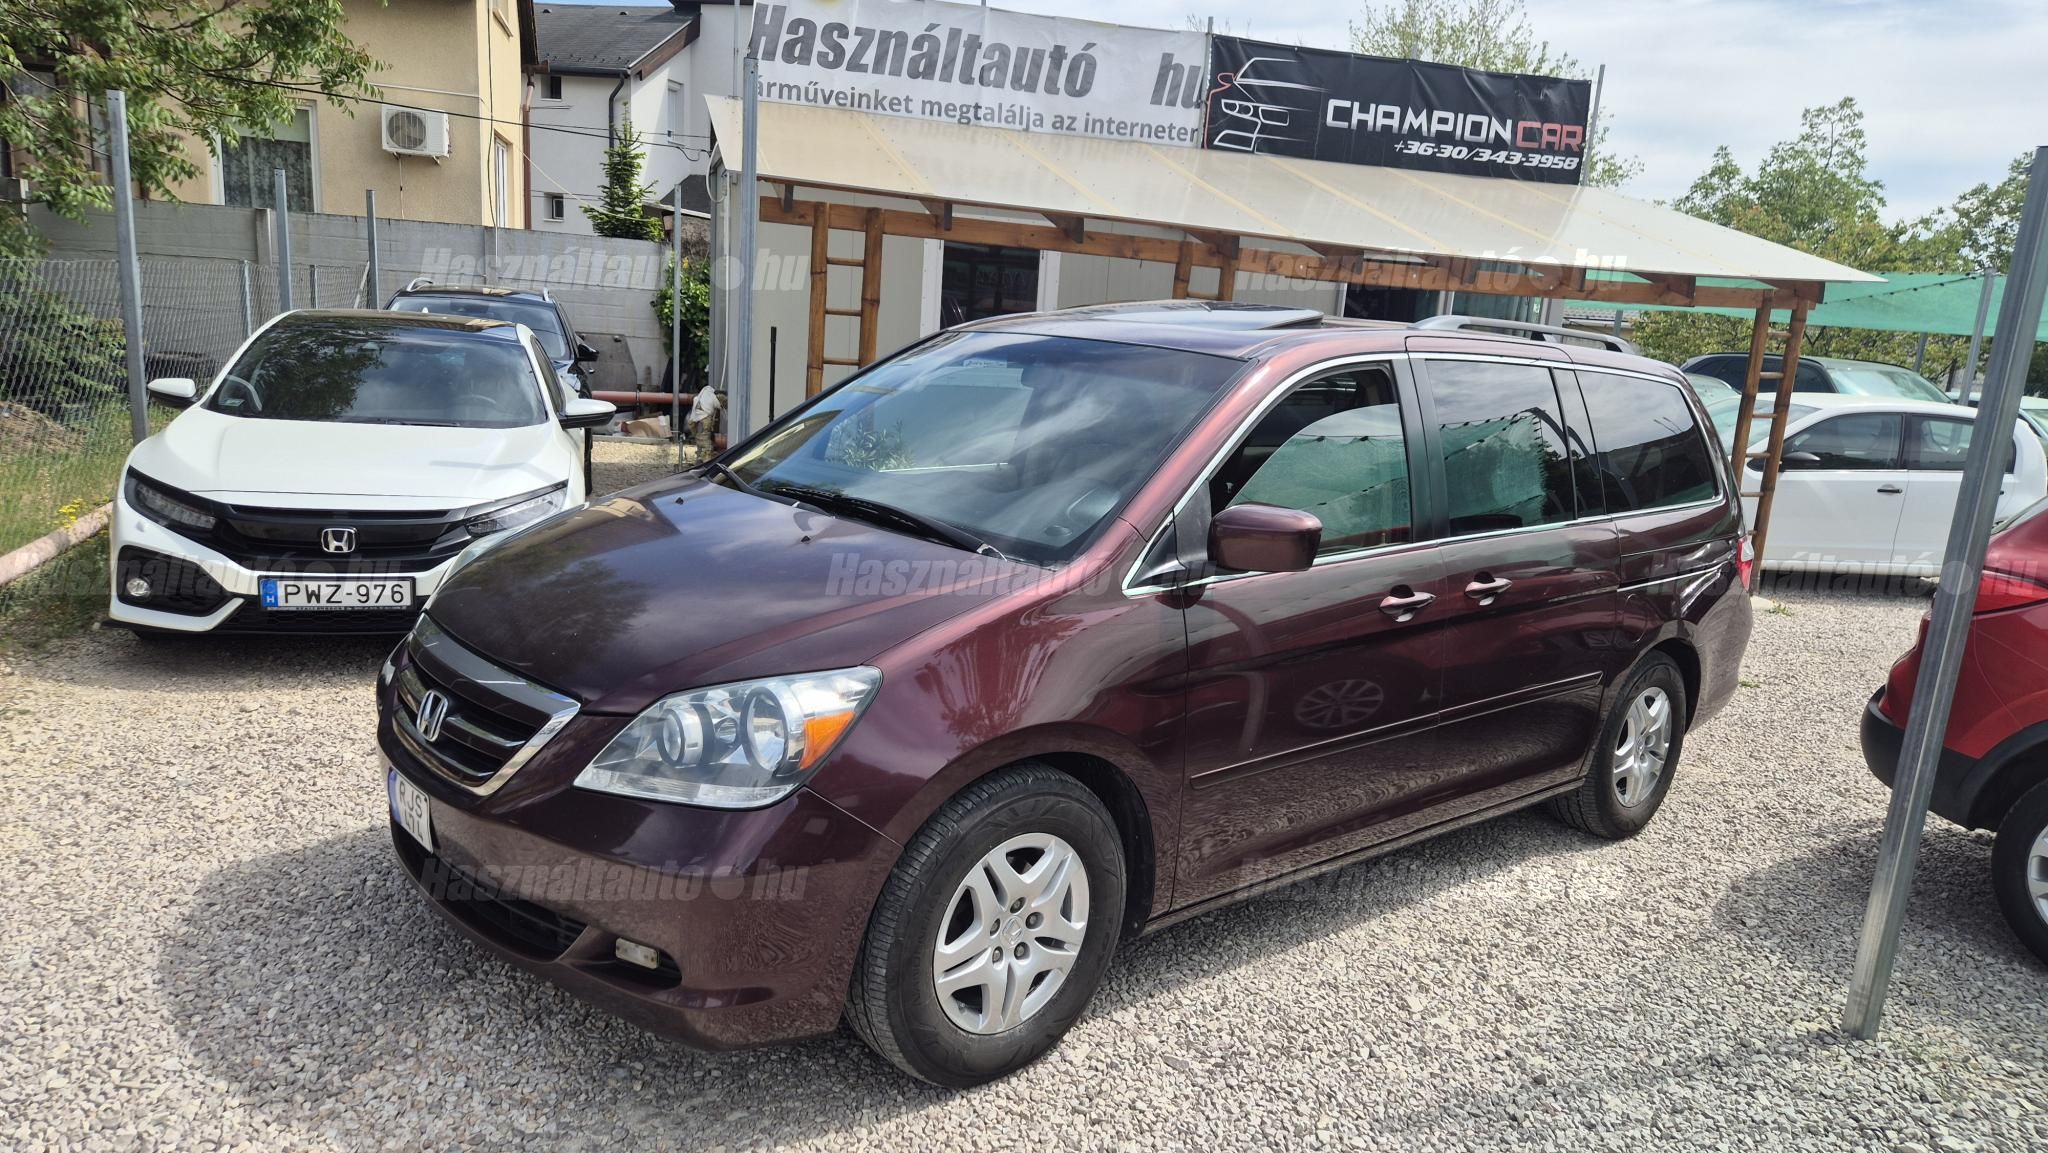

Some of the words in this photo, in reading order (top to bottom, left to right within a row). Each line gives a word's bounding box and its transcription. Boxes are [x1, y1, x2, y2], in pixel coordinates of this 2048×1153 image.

[748, 2, 1097, 98] Használtautó
[920, 100, 1044, 132] megtalálja
[1051, 114, 1080, 131] az
[283, 583, 404, 604] PWZ-976
